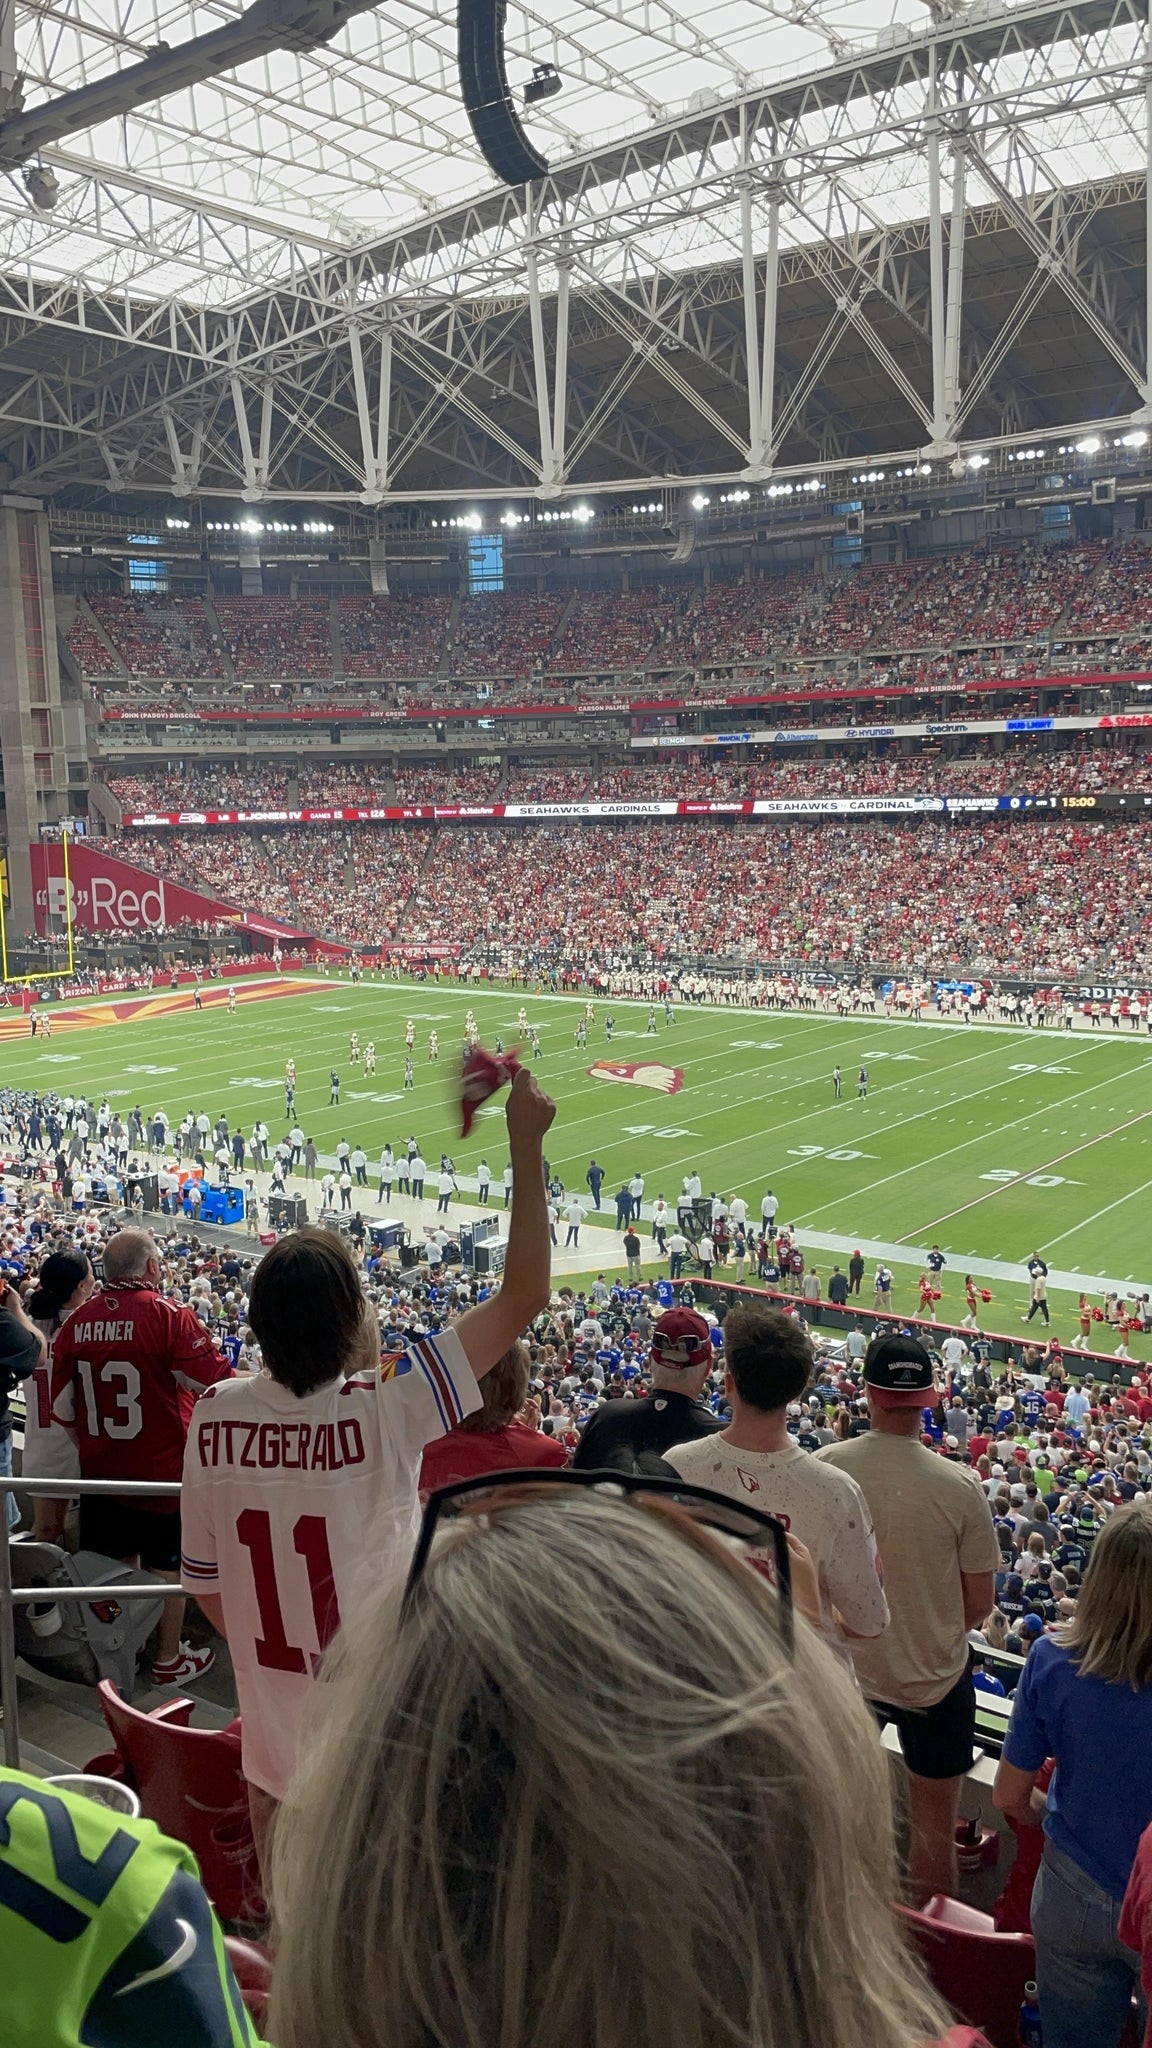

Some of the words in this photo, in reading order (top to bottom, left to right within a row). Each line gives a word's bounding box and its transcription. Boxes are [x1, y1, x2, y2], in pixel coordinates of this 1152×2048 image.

[858, 728, 895, 736] HYUNDAI
[925, 724, 964, 736] Spectrum
[768, 802, 838, 811] SEAHAWKS
[1062, 796, 1096, 807] 15:00
[370, 810, 385, 818] 126
[519, 806, 590, 814] SEAHAWKS
[600, 805, 661, 813] CARDINALS
[91, 878, 166, 927] Red
[102, 979, 149, 991] CARDIALS
[621, 1125, 690, 1138] 40
[786, 1145, 865, 1161] 30
[978, 1169, 1067, 1187] 20
[658, 1288, 669, 1298] 12
[74, 1320, 134, 1344] WARNER
[78, 1360, 143, 1440] 13
[1026, 1401, 1040, 1414] 16
[199, 1418, 366, 1471] FITZGERALD
[236, 1508, 343, 1681] 11
